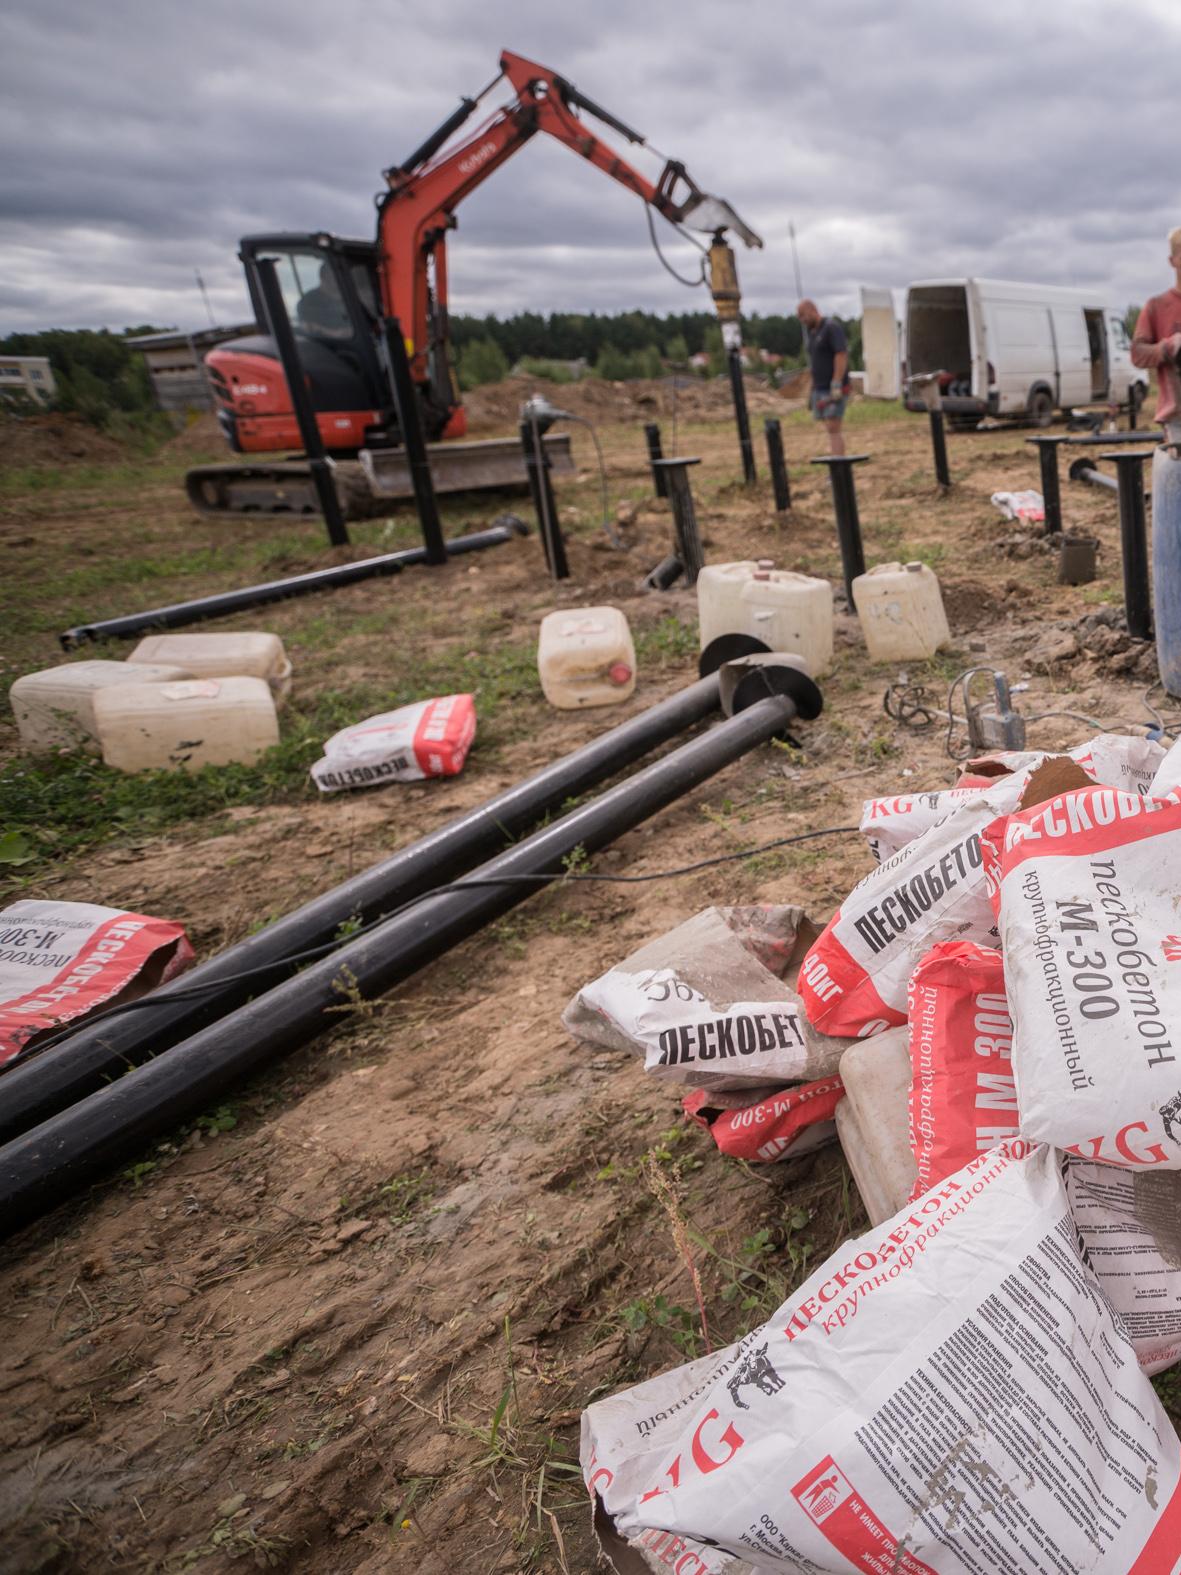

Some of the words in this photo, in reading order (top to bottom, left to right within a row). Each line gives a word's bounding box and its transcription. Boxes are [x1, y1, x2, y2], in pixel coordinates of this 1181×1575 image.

[869, 798, 912, 820] KG
[854, 833, 983, 955] ПЕСКОБЕТО
[1023, 869, 1096, 1092] крупнофракционный
[1055, 900, 1121, 1021] М-300
[1090, 858, 1177, 1070] пескобетон
[658, 1012, 806, 1066] ПЕСКОБЕТ
[731, 1099, 791, 1130] М-300
[784, 1180, 963, 1342] ПЕСКОБЕТОН
[821, 1158, 1009, 1337] крупнофракционн
